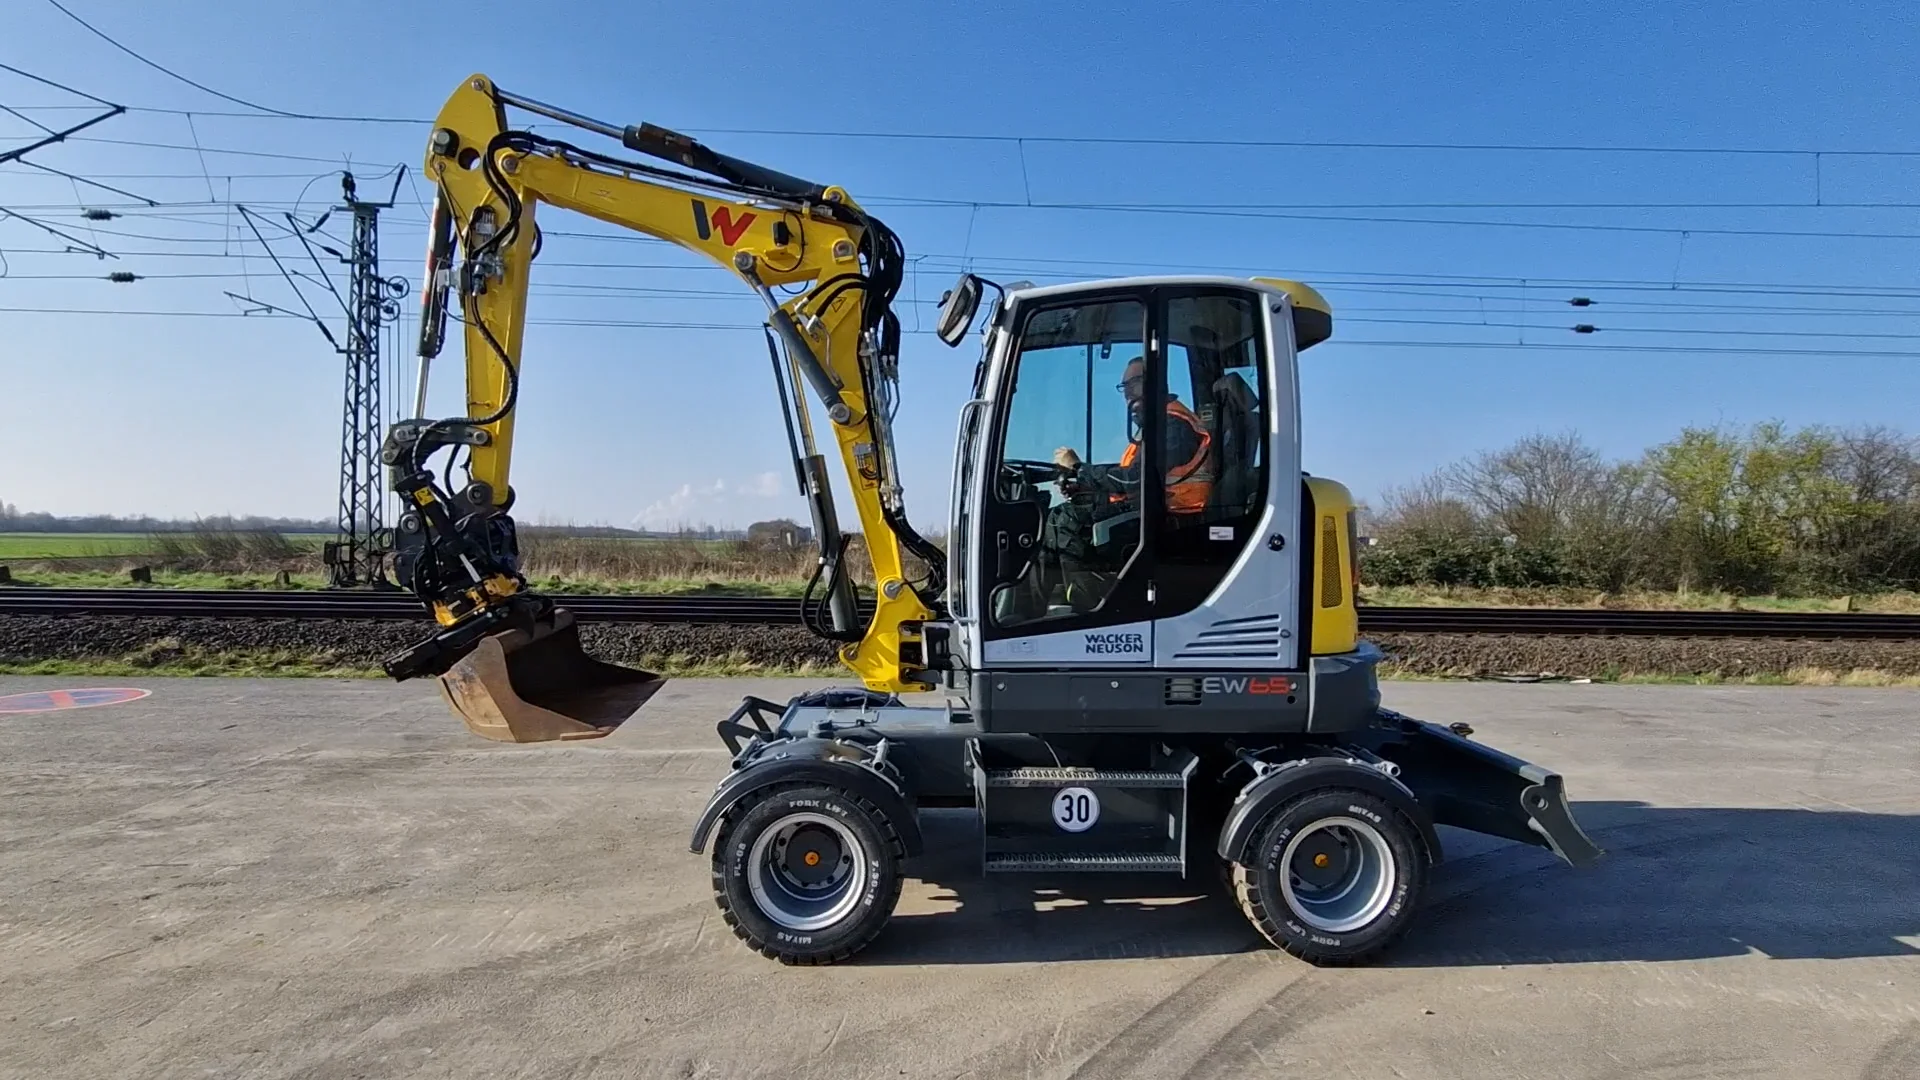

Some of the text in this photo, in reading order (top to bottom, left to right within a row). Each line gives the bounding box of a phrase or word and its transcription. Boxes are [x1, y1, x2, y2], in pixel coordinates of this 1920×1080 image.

[1084, 633, 1144, 644] WACKER
[1085, 643, 1144, 654] NEUSON
[1202, 676, 1290, 695] EW65
[789, 800, 848, 818] FORK LIFT
[1060, 794, 1090, 823] 30
[1348, 805, 1382, 823] MITAS
